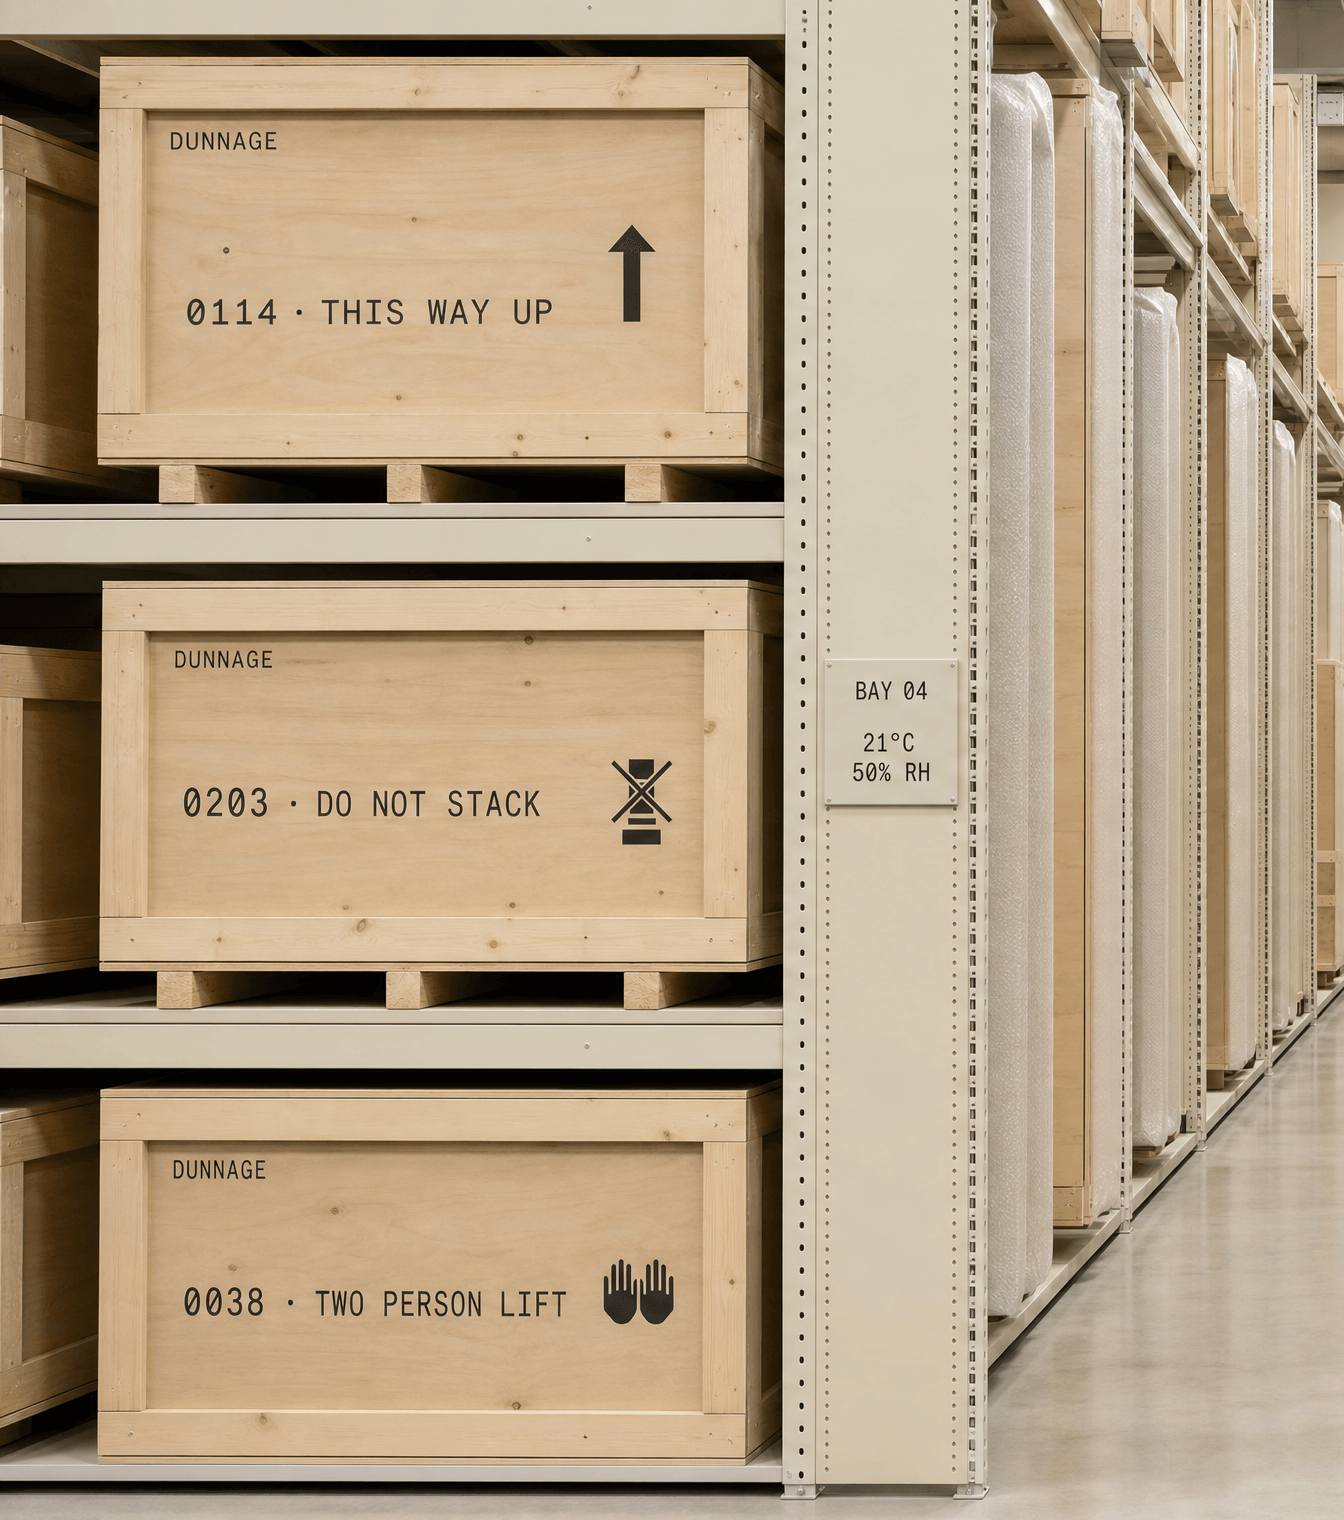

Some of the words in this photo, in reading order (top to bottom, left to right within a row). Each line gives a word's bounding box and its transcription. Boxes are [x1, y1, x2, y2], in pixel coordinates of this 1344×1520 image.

[170, 131, 277, 151] DUNNAGE
[186, 298, 277, 326] 0114
[321, 298, 404, 326] THIS
[427, 298, 490, 325] WAY
[513, 298, 553, 325] UP
[174, 650, 273, 669] DUNNAGE
[855, 680, 893, 701] BAY
[903, 680, 928, 701] 04
[863, 732, 915, 753] 21°C
[852, 761, 892, 782] 50%
[905, 761, 930, 782] RH
[183, 786, 268, 818] 0203
[317, 789, 352, 818] DO
[373, 789, 426, 818] NOT
[447, 789, 541, 818] STACK
[173, 1159, 266, 1180] DUNNAGE
[184, 1286, 264, 1317] 0038
[315, 1289, 364, 1317] TWO
[383, 1290, 482, 1317] PERSON
[501, 1290, 567, 1318] LIFT
